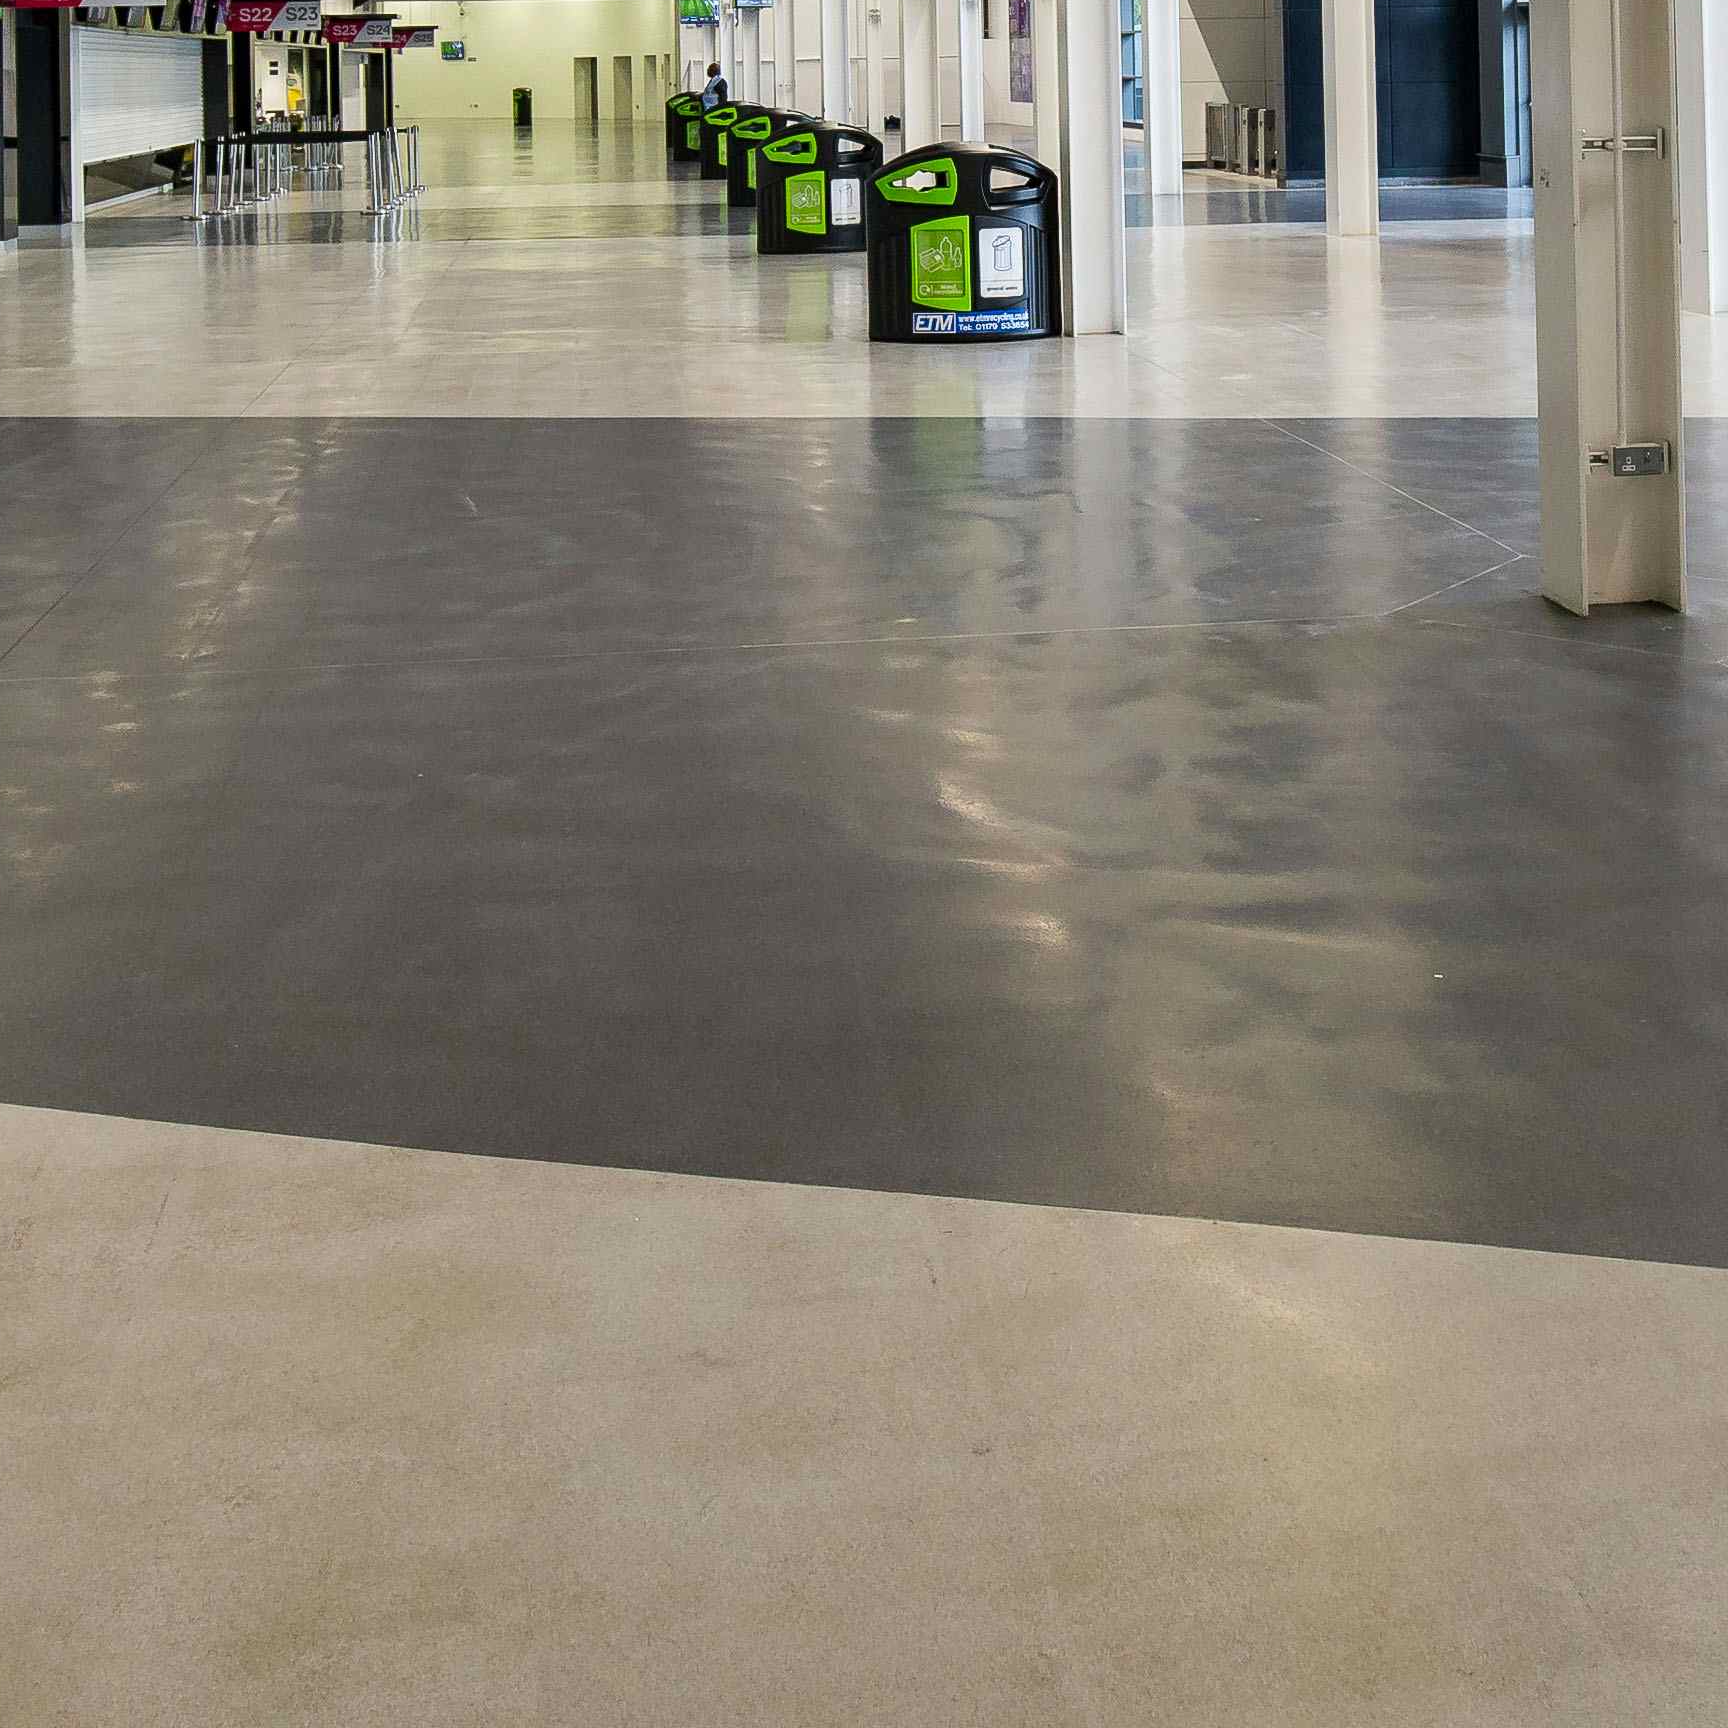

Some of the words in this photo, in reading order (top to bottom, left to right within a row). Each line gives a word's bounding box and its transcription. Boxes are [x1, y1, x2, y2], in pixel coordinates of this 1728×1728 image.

[239, 8, 272, 22] S22
[285, 7, 319, 22] S23
[332, 24, 358, 36] S23
[366, 24, 390, 36] S24
[916, 314, 953, 331] ETM
